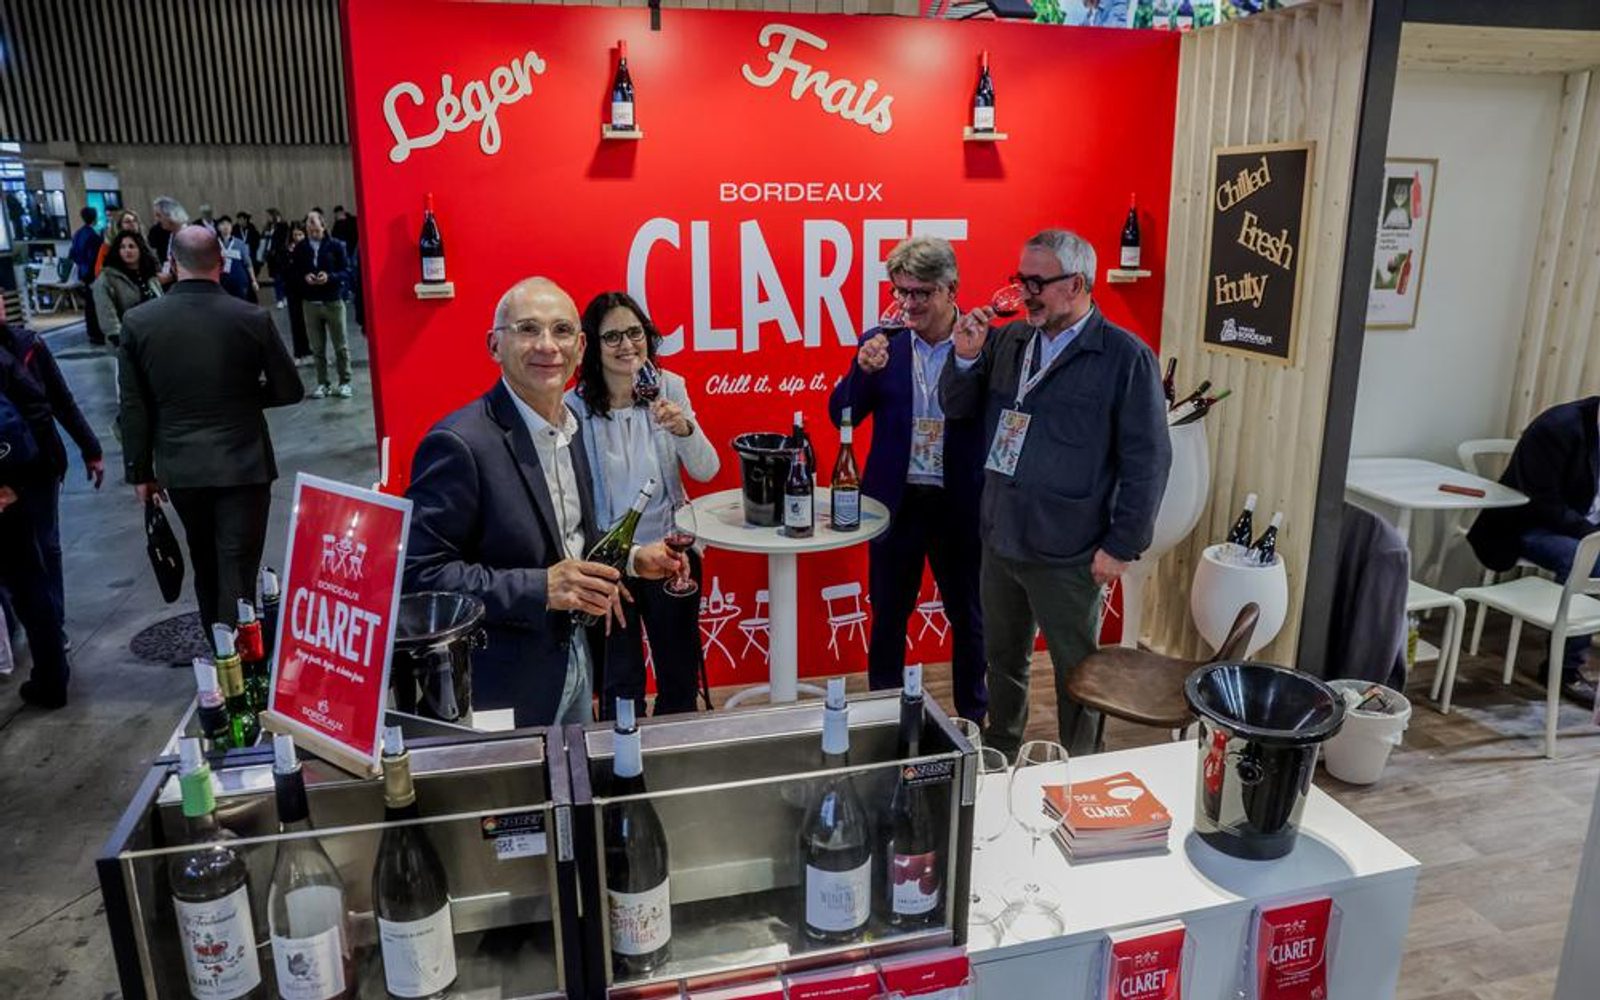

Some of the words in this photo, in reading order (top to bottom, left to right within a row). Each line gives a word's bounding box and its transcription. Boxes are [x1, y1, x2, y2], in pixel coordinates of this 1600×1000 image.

[741, 23, 897, 135] Frais
[382, 49, 548, 164] Léger
[719, 181, 884, 203] BORDEAUX
[1216, 155, 1271, 212] Chilled
[1237, 210, 1293, 270] Fresh
[1215, 272, 1268, 309] Fruity
[705, 374, 752, 395] Chill
[778, 375, 806, 396] sip
[291, 586, 382, 667] CLARET
[1082, 805, 1132, 819] CLARET
[1271, 937, 1317, 965] CLARET
[1120, 968, 1170, 998] CLARET
